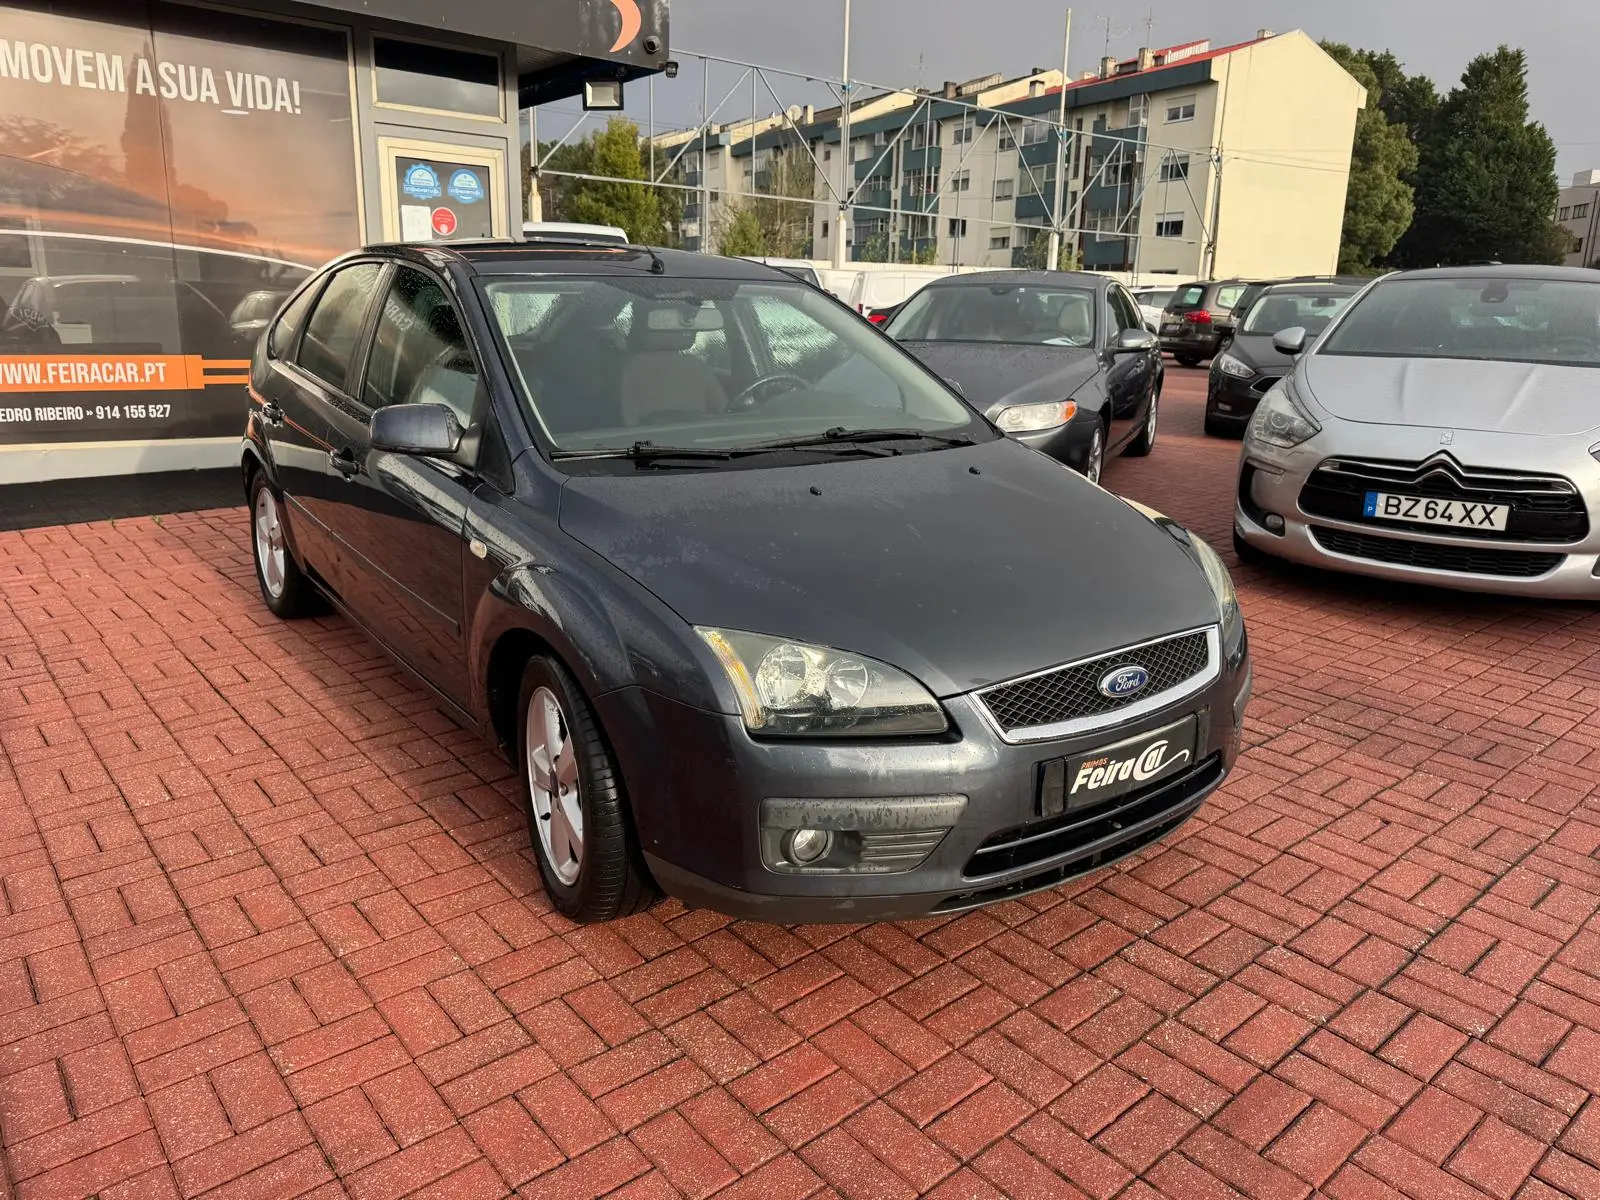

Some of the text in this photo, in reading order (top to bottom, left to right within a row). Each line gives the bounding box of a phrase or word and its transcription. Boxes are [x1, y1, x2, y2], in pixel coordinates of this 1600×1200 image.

[0, 38, 125, 93] MOVEM
[225, 70, 302, 115] VIDA!
[0, 362, 167, 385] WW.FEIRACAR.PT
[35, 406, 84, 422] RIBEIRO
[96, 405, 120, 420] 914
[123, 404, 146, 419] 155
[148, 404, 171, 419] 527
[1115, 671, 1140, 692] Ford
[1081, 757, 1108, 770] PRIMOS
